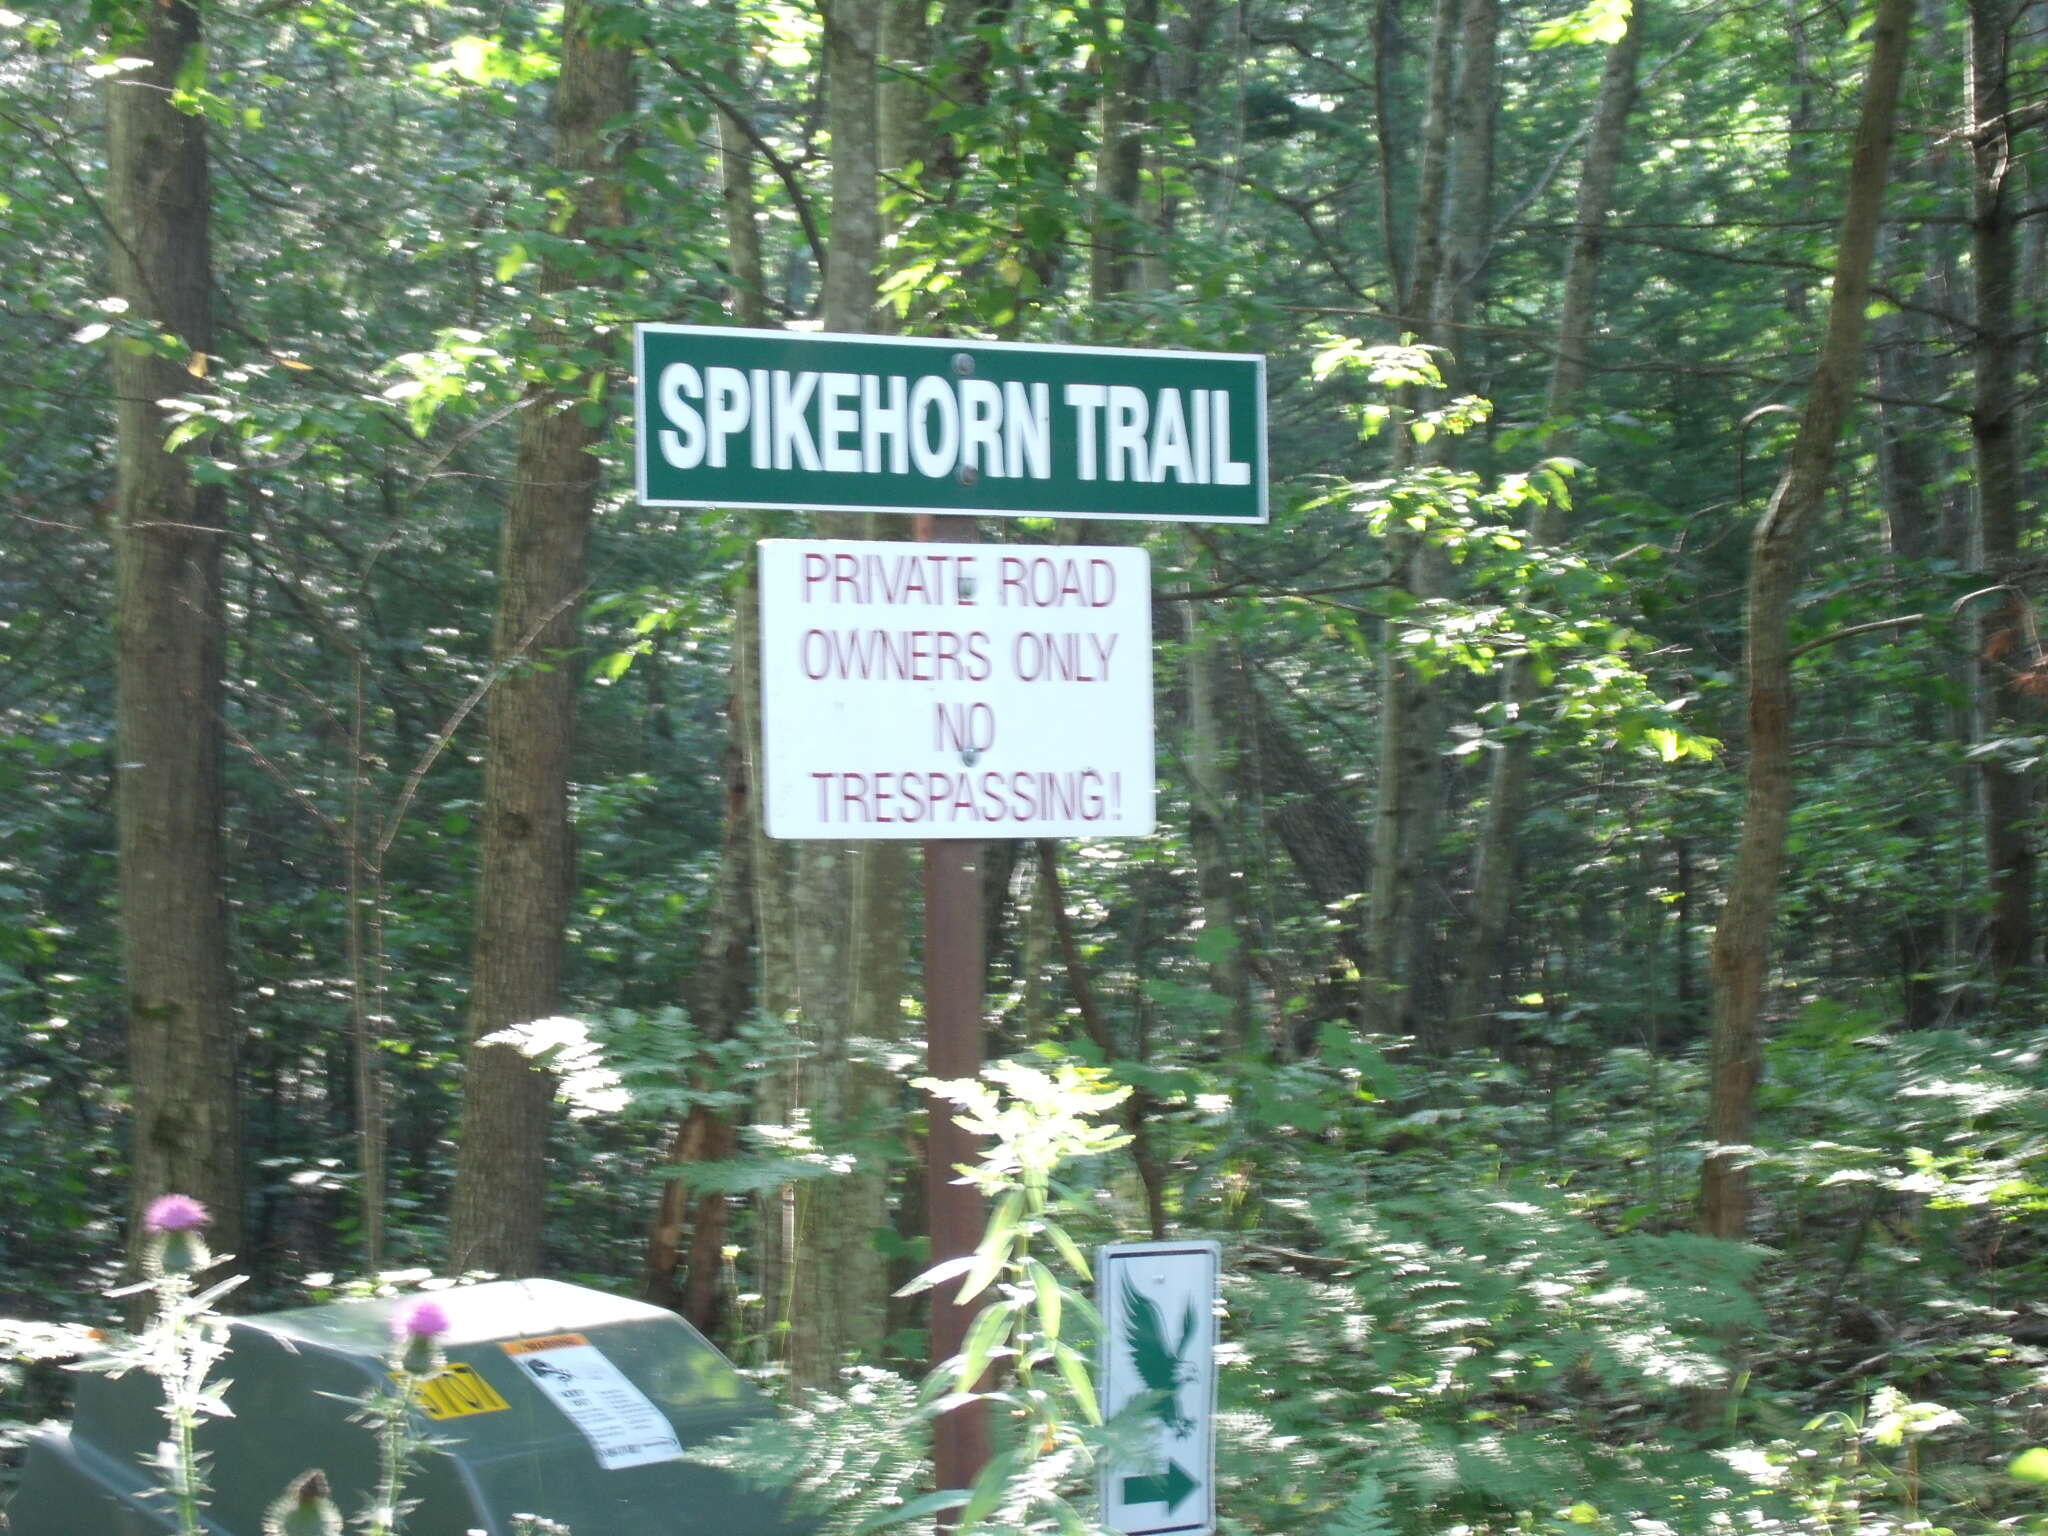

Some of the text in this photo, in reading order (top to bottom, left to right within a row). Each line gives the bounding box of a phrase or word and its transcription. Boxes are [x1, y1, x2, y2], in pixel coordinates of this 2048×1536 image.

[659, 361, 1251, 485] SPIKEHORN TRAIL
[802, 553, 1116, 608] PRIVATE ROAD
[800, 628, 1118, 682] OWNERS ONLY
[934, 702, 995, 753] NO
[810, 772, 1122, 823] TRESPASSING!
